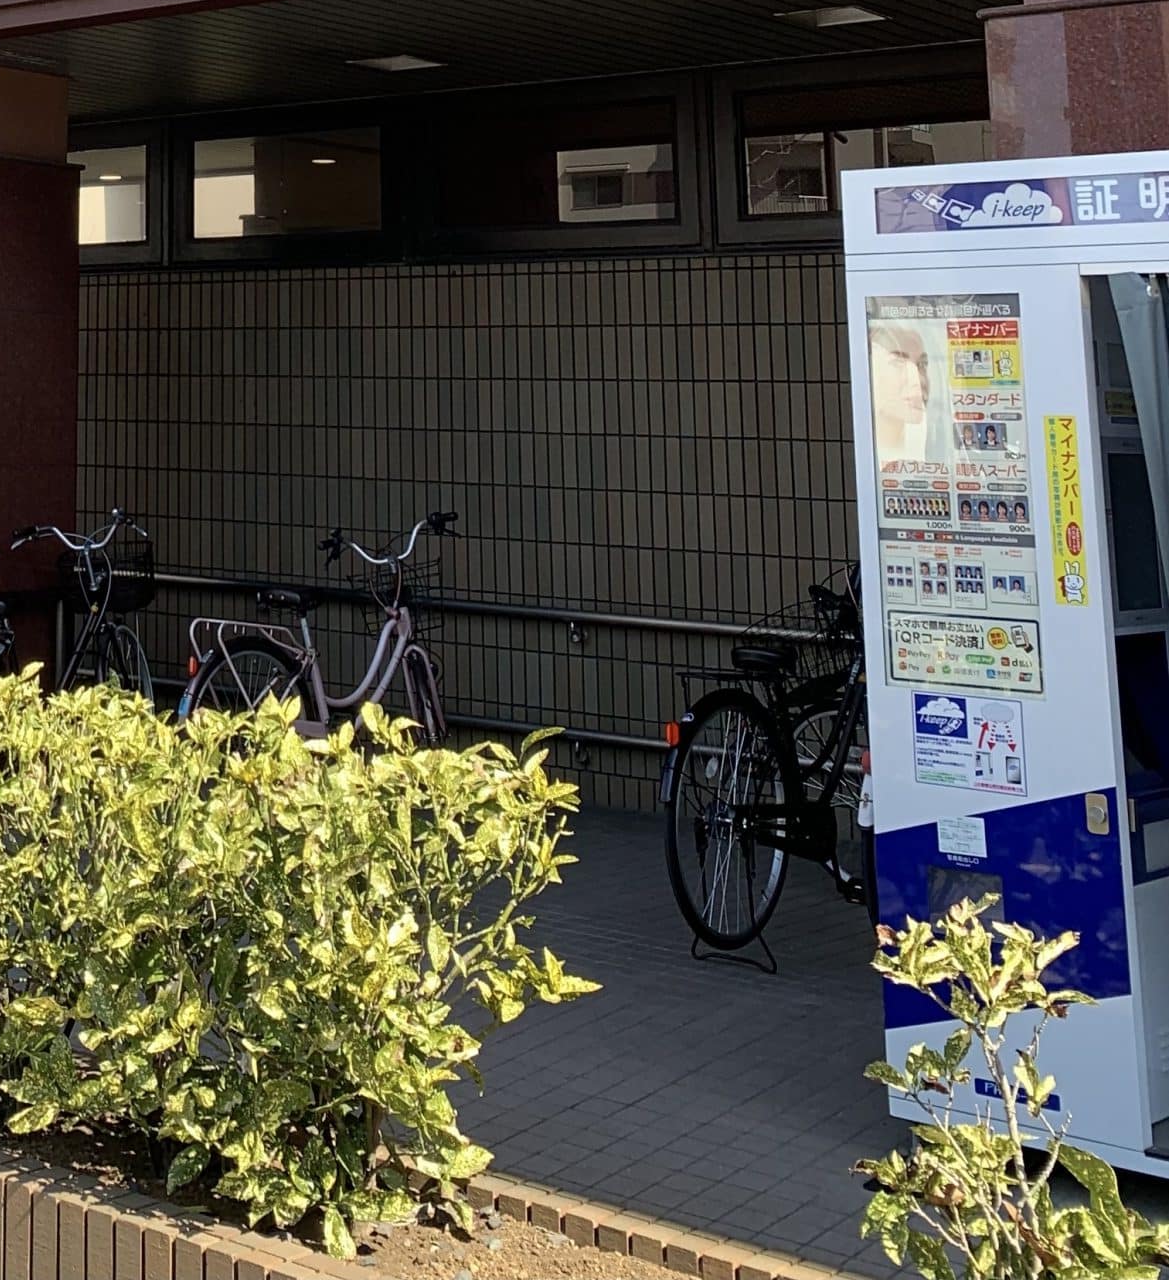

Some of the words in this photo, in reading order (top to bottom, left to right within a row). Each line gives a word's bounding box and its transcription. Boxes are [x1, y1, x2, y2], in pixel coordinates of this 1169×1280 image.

[992, 200, 1045, 222] i-keep
[947, 323, 1018, 337] マイナンバー
[952, 392, 1022, 407] スタンダード
[1058, 418, 1078, 516] マイナンバー
